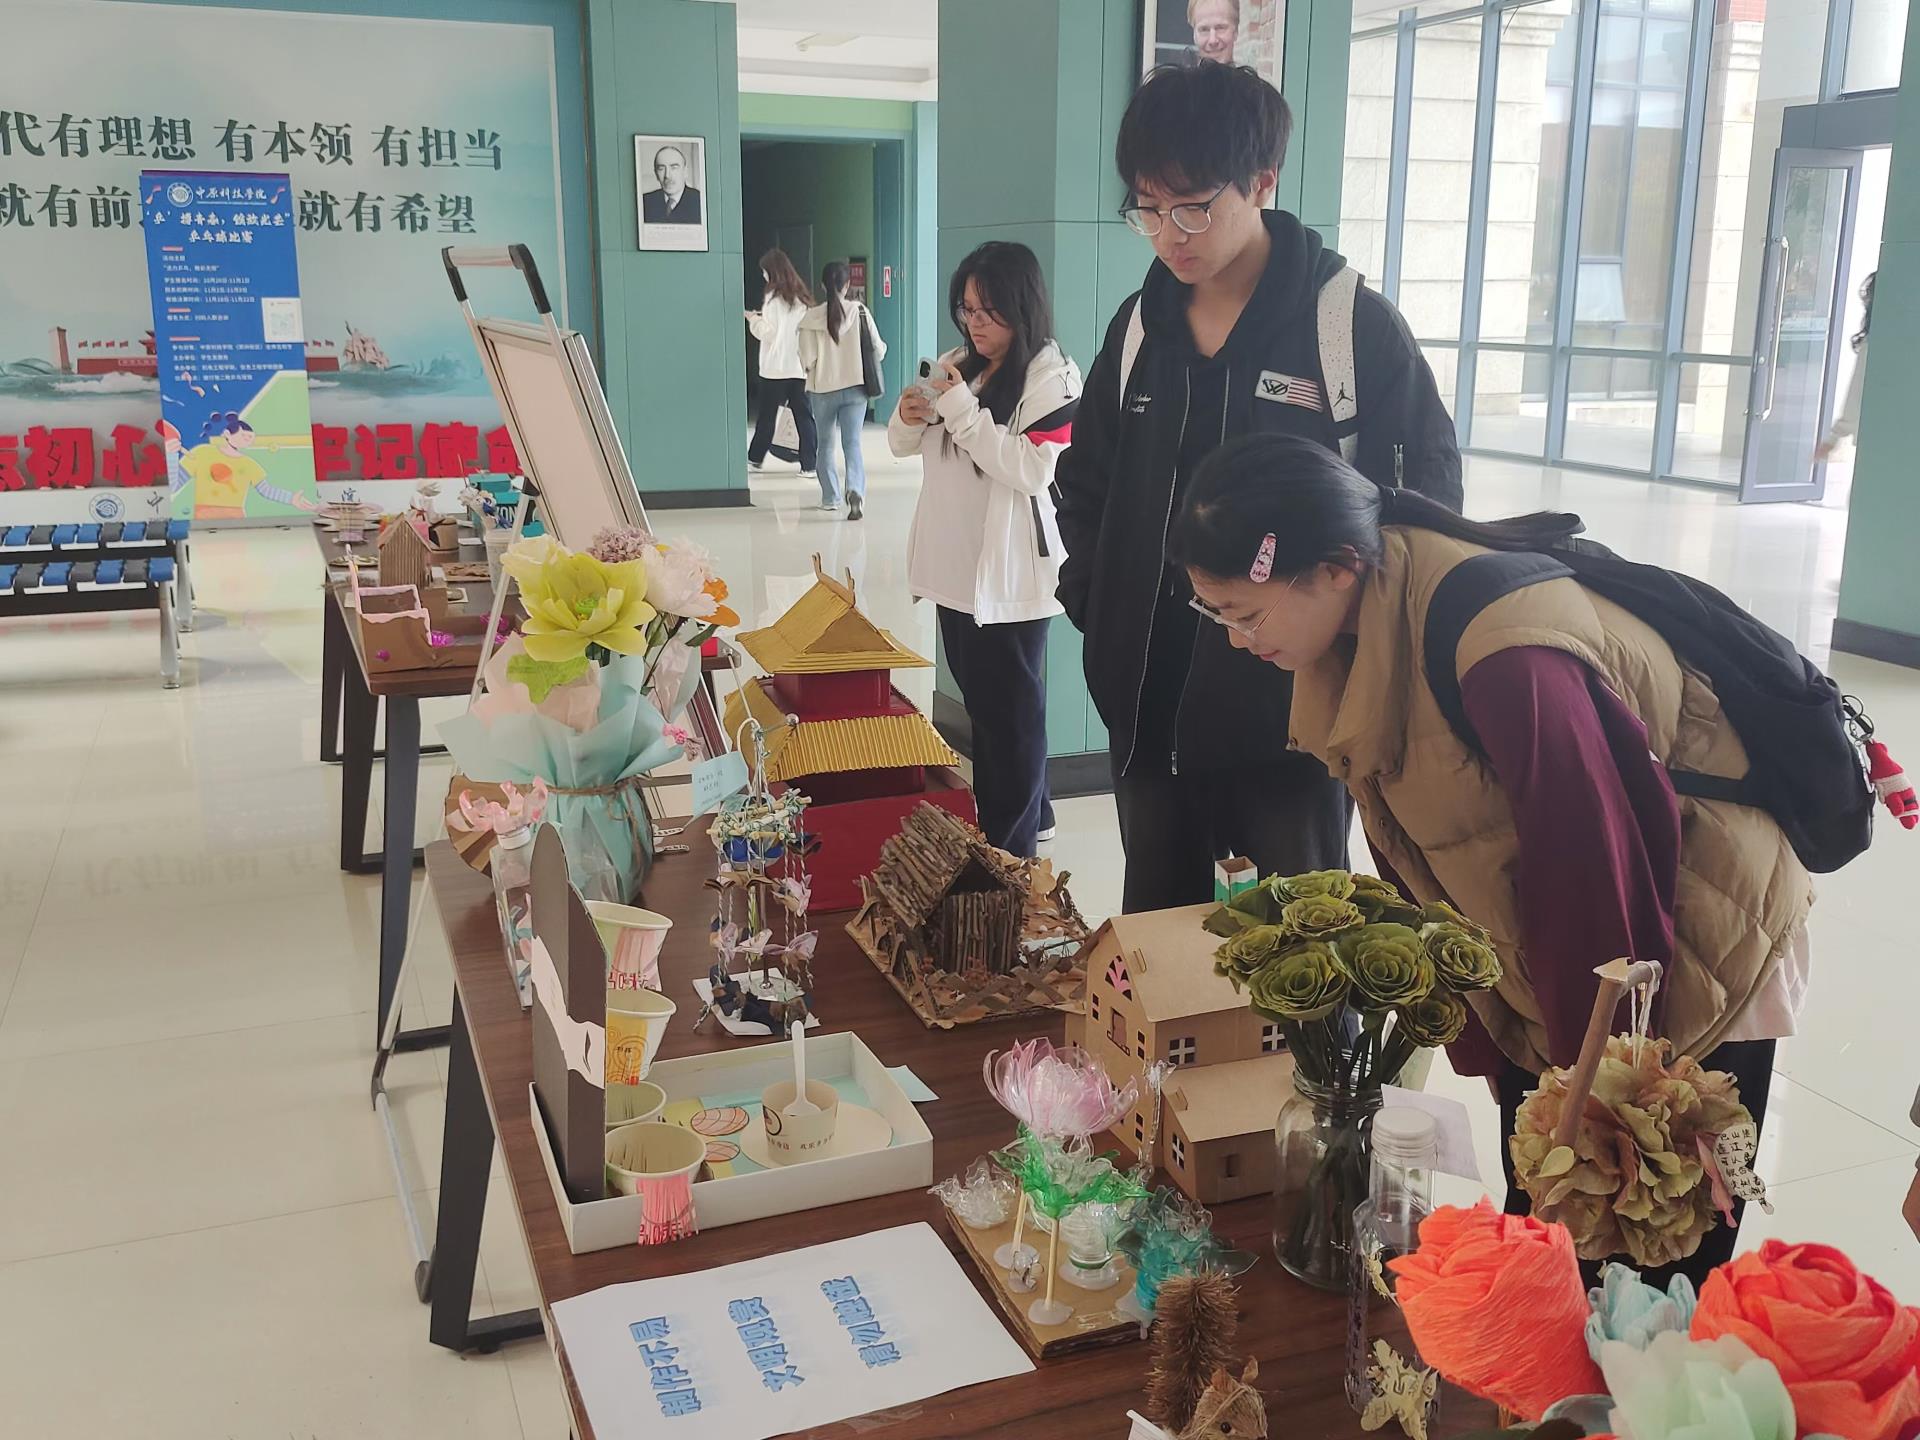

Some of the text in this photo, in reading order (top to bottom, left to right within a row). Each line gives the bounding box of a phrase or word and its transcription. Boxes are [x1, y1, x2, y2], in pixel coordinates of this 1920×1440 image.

[0, 110, 501, 171] 代有理想 有本领 有担当
[0, 183, 476, 233] 就有前 就有希望
[629, 1317, 702, 1418] 制作不易
[727, 1296, 806, 1393] 文明观赏
[820, 1275, 902, 1369] 请勿触碰
